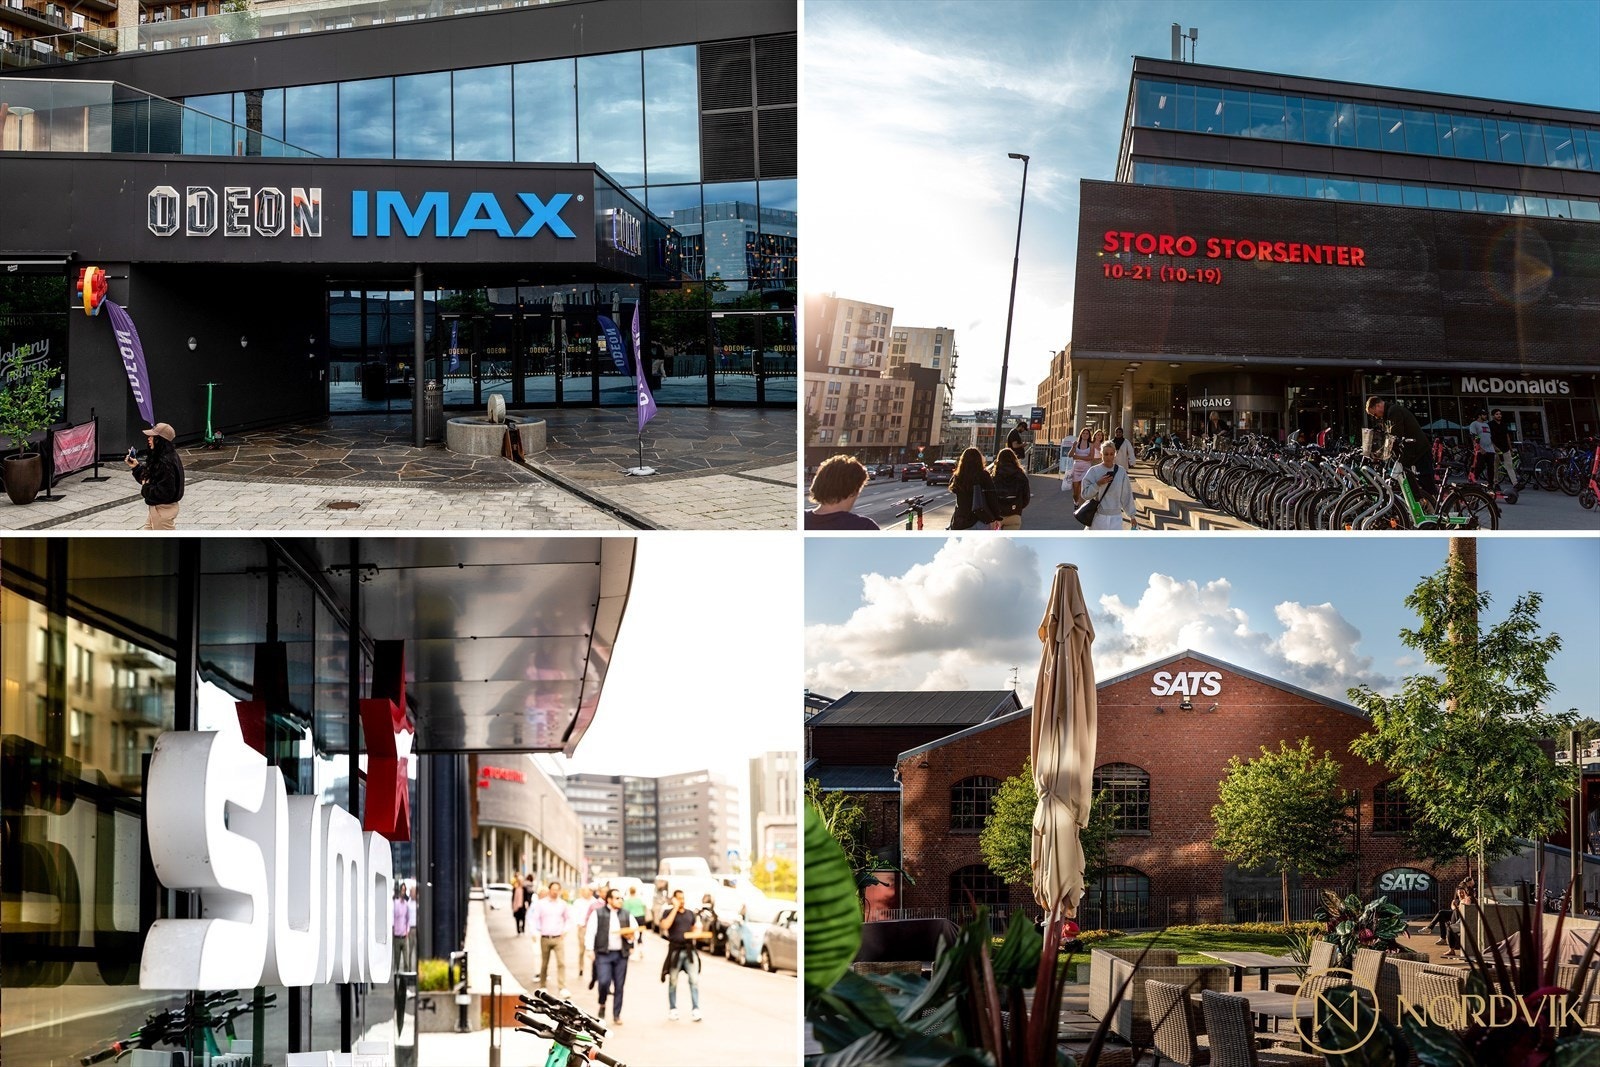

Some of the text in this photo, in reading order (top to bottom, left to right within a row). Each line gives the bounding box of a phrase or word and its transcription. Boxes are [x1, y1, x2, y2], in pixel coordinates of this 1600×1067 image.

[147, 185, 577, 239] ODEON IMAX
[1103, 231, 1366, 267] STORO STORSENTER
[1103, 263, 1222, 285] 10-21 (10-19)
[1461, 376, 1570, 394] McDonald's
[1189, 398, 1231, 408] INNGANG
[1150, 671, 1223, 696] SATS
[1380, 873, 1431, 891] SATS
